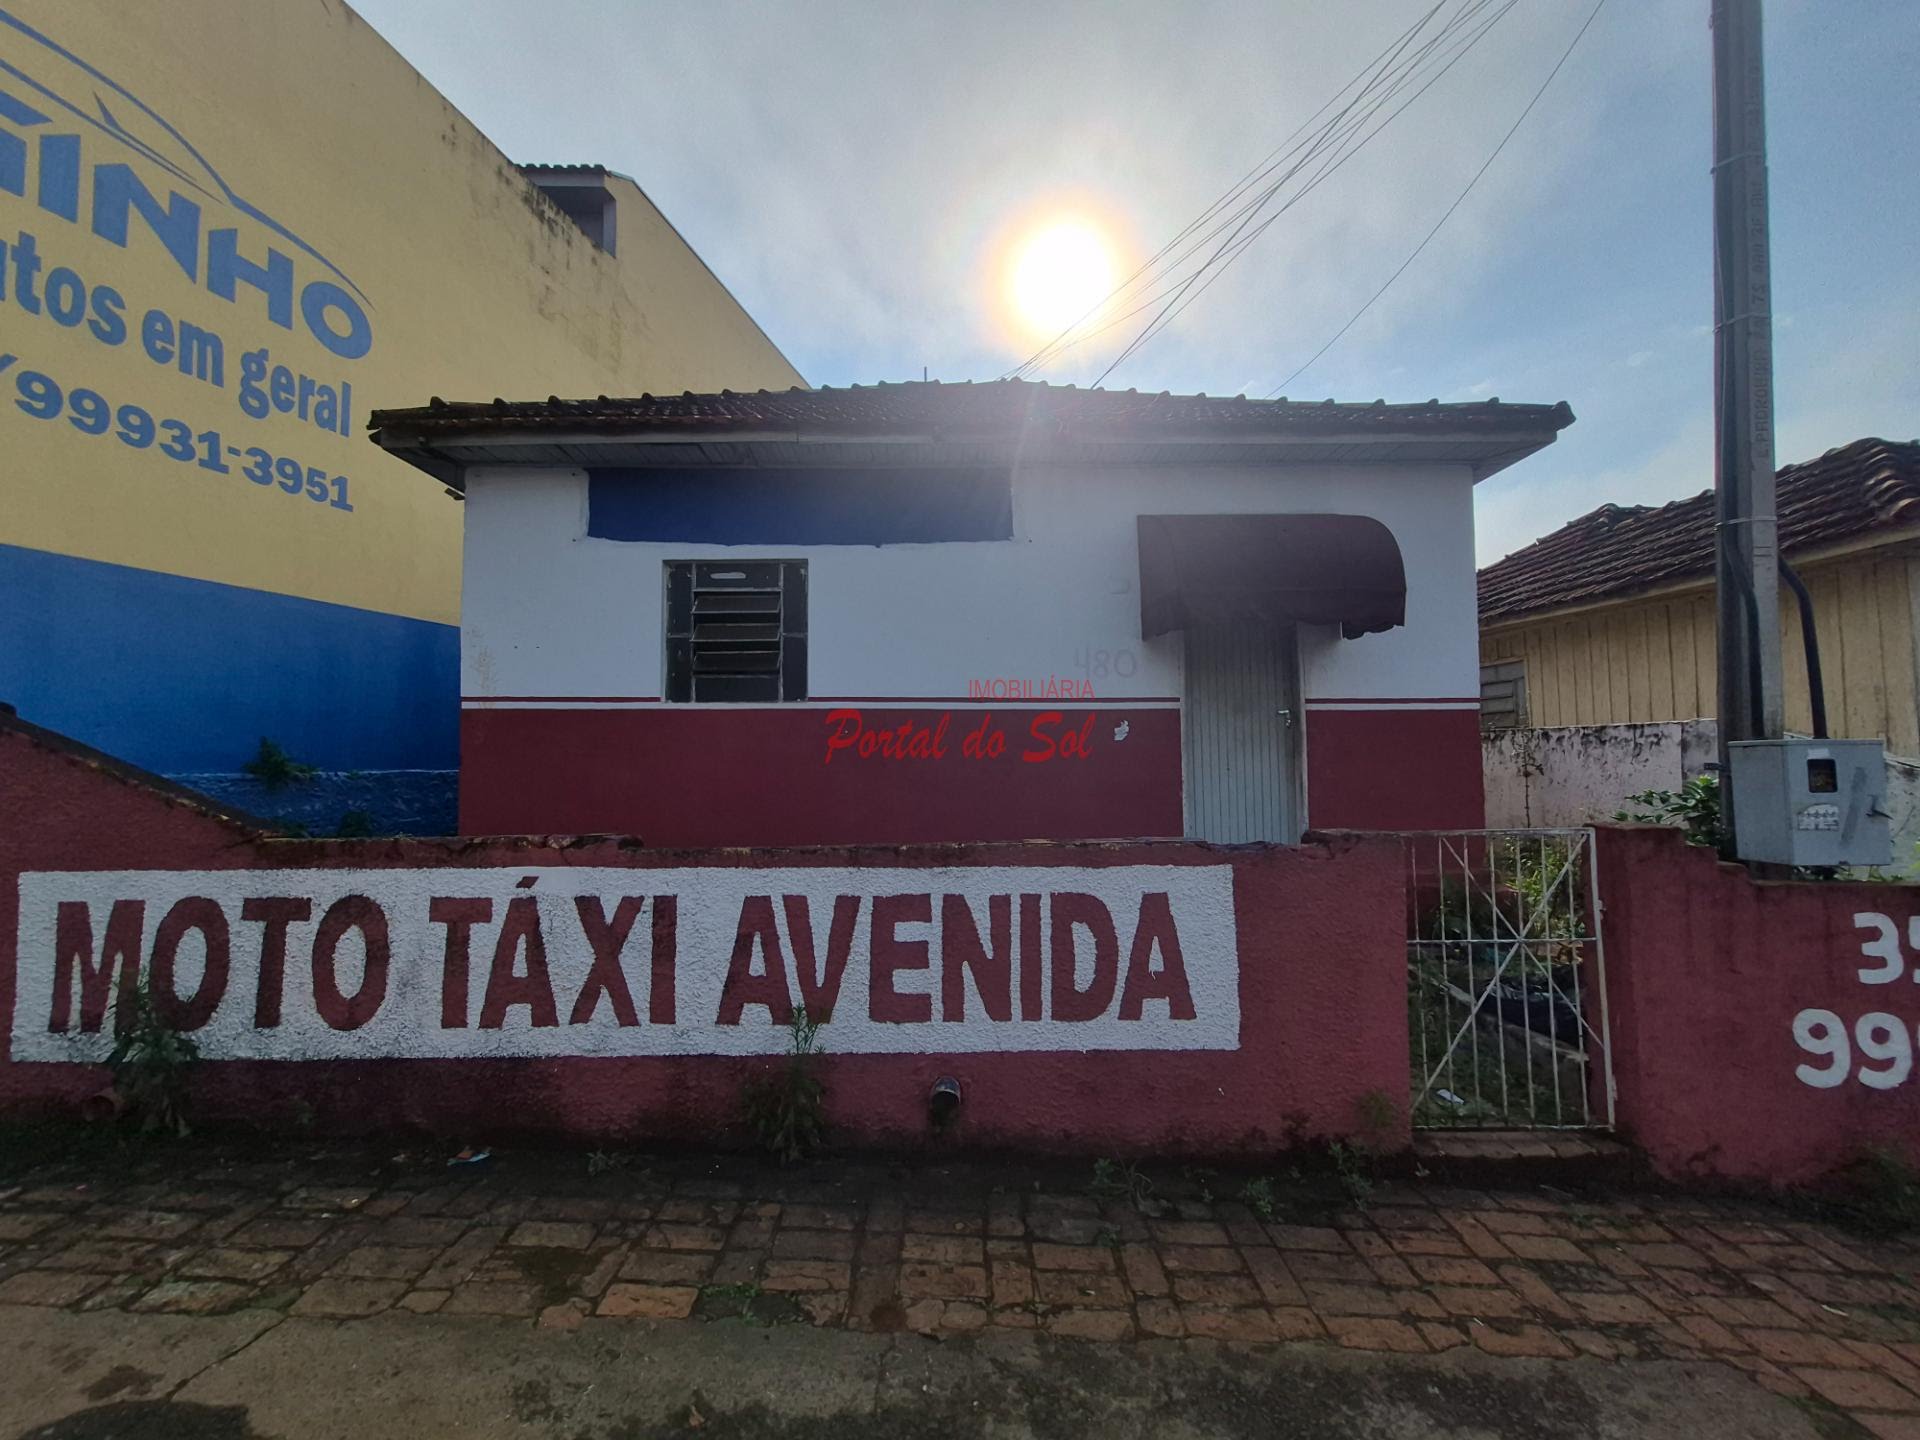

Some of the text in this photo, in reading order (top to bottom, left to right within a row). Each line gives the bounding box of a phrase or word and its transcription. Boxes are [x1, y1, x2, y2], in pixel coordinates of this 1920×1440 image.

[142, 309, 224, 388] em
[239, 348, 352, 437] geral
[48, 876, 1198, 1033] MOTO TÁXI AVENIDA
[1792, 1008, 1920, 1089] 99
